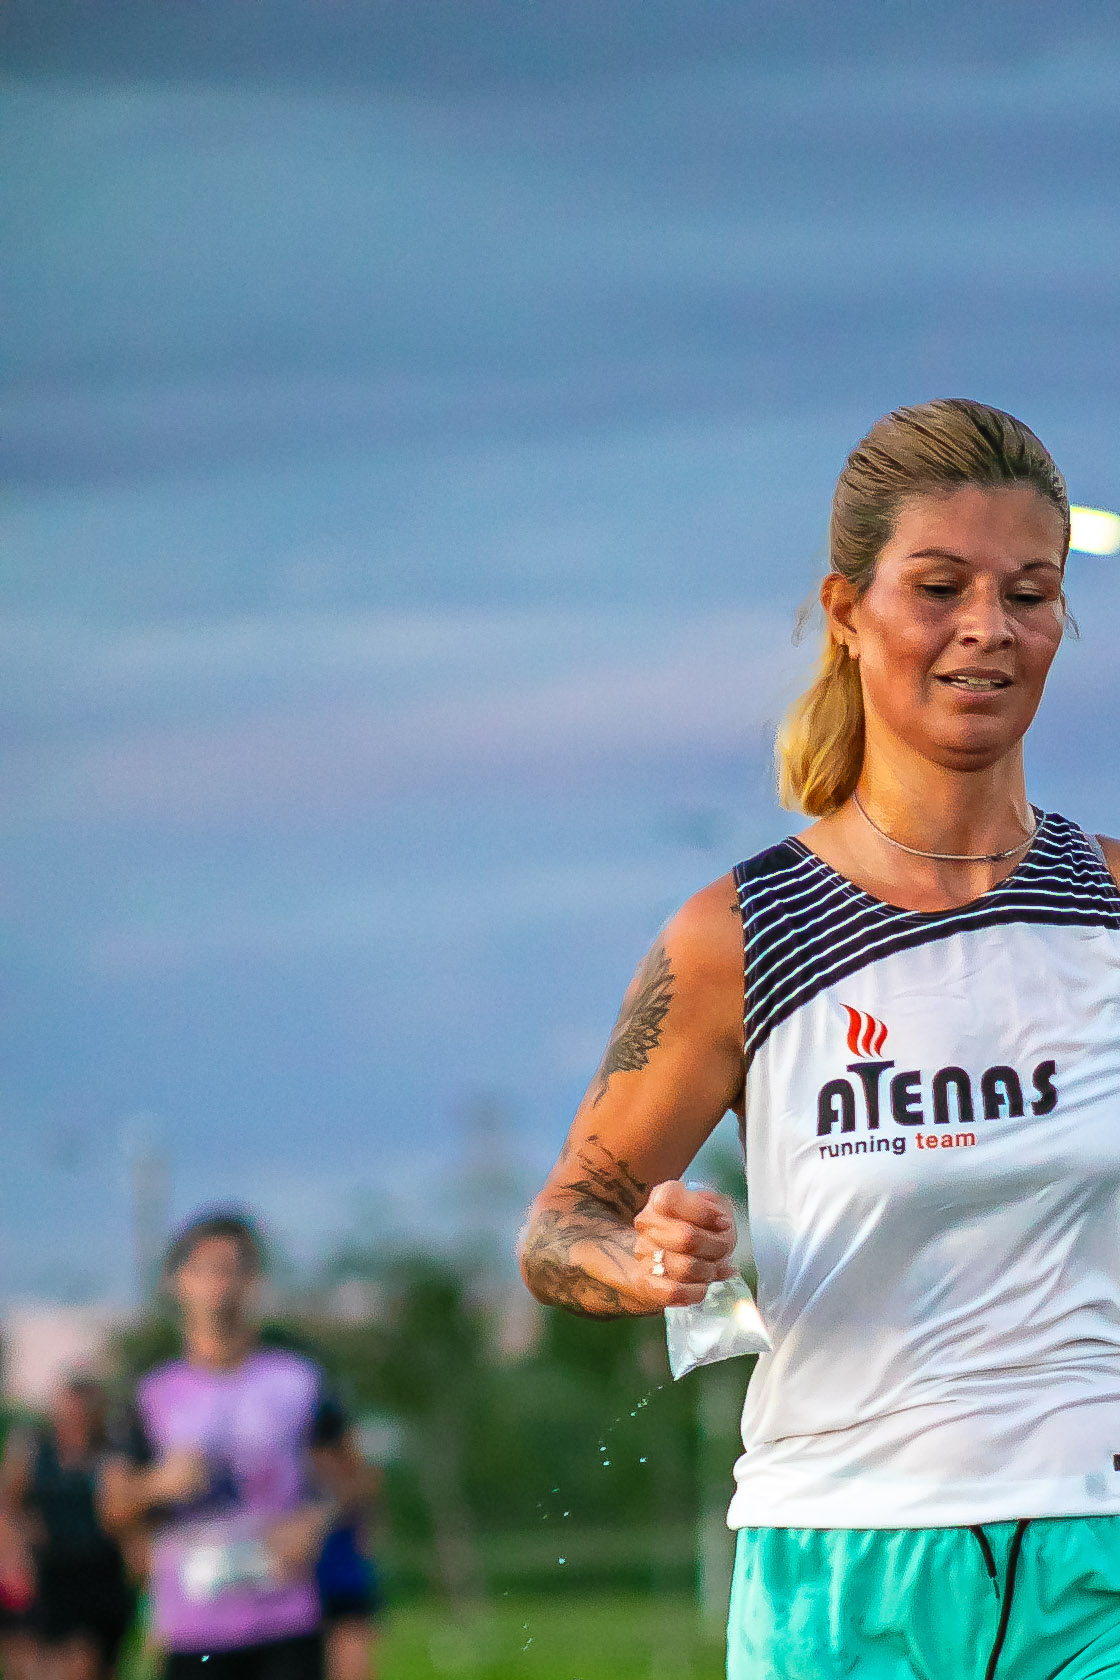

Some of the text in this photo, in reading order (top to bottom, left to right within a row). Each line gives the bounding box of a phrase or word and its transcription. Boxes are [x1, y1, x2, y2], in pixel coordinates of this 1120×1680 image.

[816, 1060, 1059, 1137] ATENAS
[819, 1131, 977, 1159] running team
